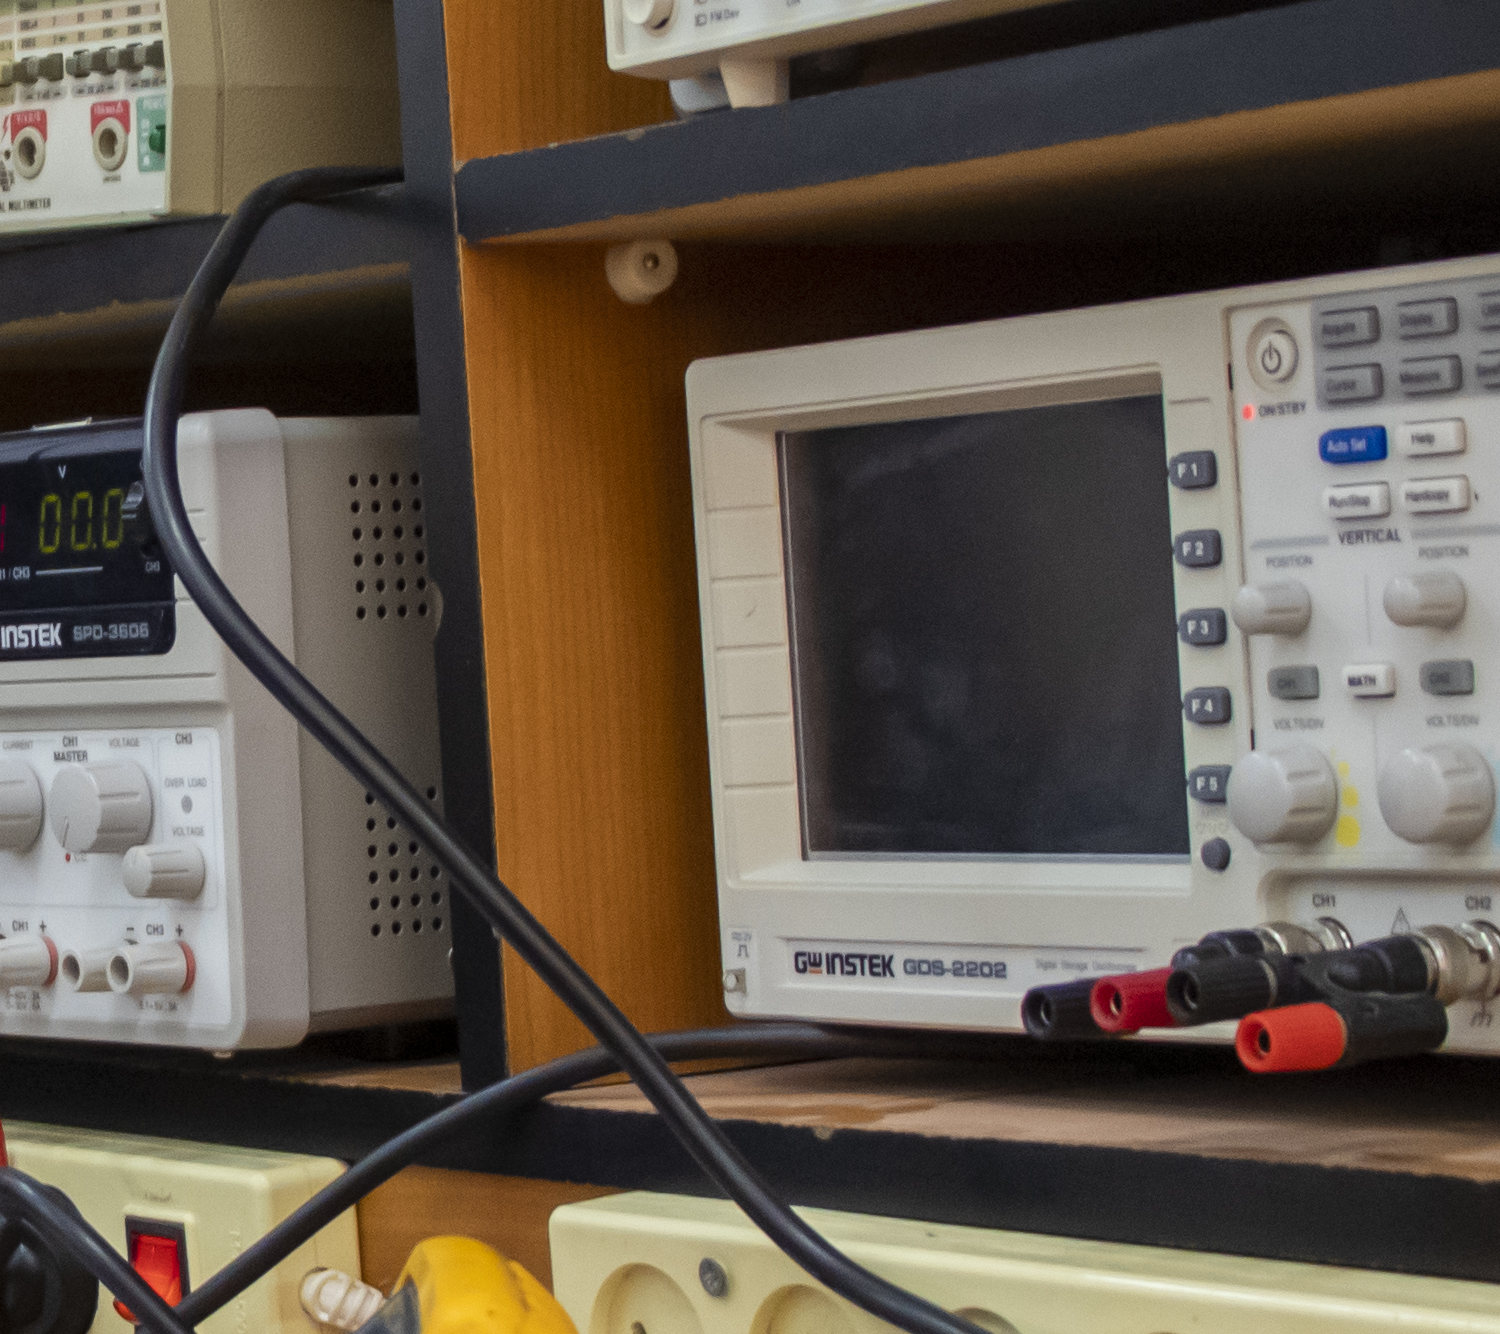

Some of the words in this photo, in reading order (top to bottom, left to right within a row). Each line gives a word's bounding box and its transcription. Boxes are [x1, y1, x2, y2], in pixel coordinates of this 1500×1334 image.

[8, 197, 52, 212] MULTIMETER
[1337, 527, 1402, 546] VERTICAL
[1418, 544, 1471, 559] POSITION
[1265, 554, 1315, 568] POSITION
[1346, 674, 1378, 688] MATH
[52, 750, 89, 763] MASTER
[1311, 893, 1337, 909] CH1
[1464, 894, 1493, 912] CH2
[11, 919, 30, 933] CH1
[145, 922, 166, 937] CH3
